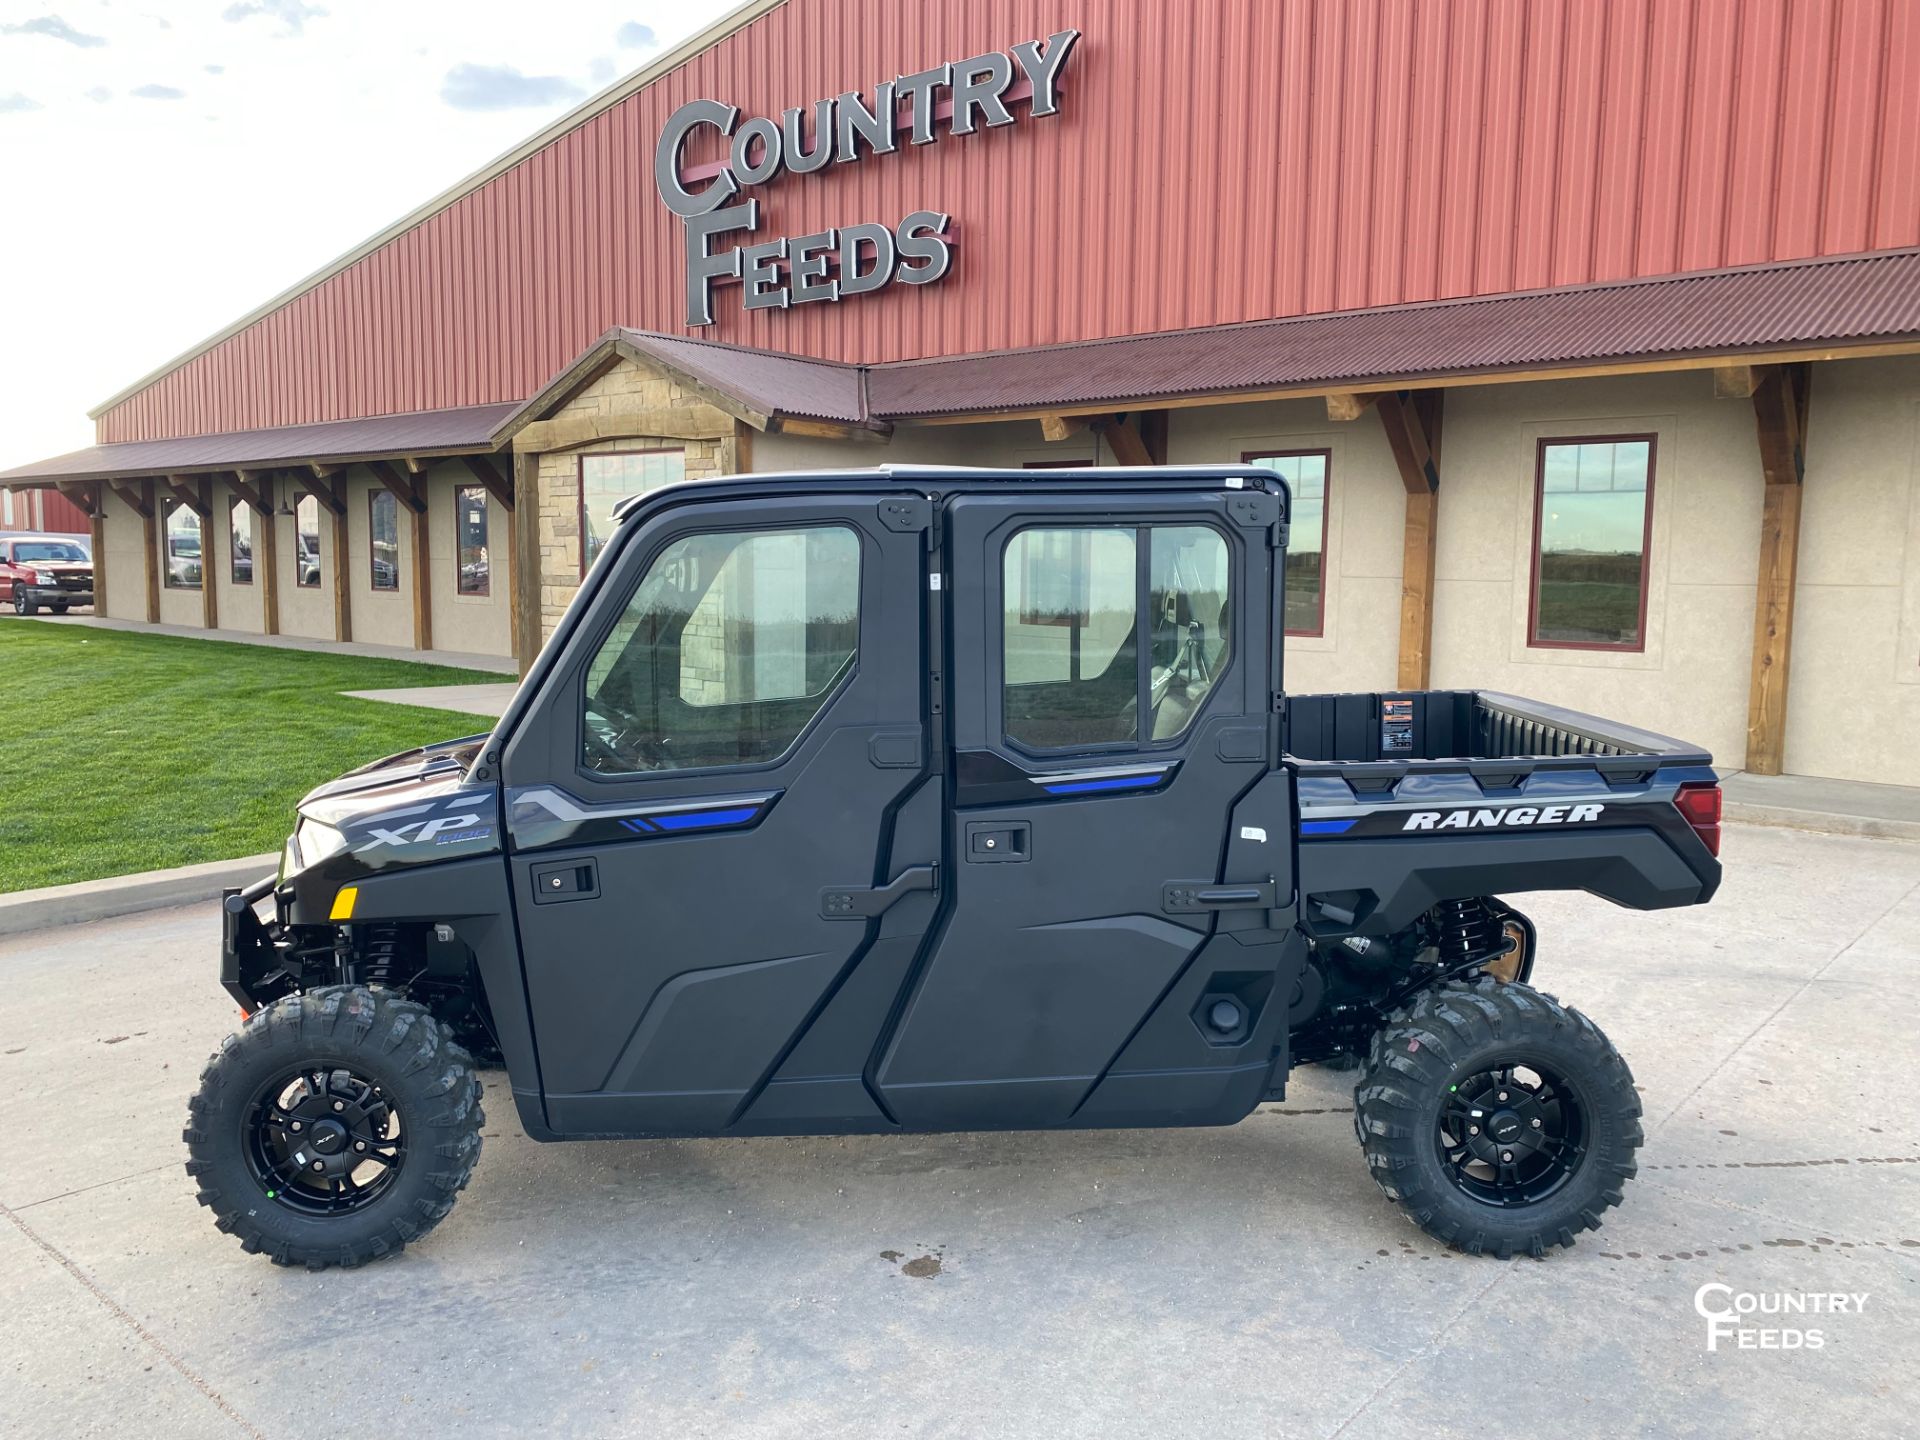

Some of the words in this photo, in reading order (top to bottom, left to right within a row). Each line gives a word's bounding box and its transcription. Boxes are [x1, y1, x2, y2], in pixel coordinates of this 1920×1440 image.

[655, 29, 1081, 217] COUNTRY
[684, 198, 953, 327] FEEDS
[353, 813, 481, 853] XP
[1402, 804, 1605, 831] RANGER
